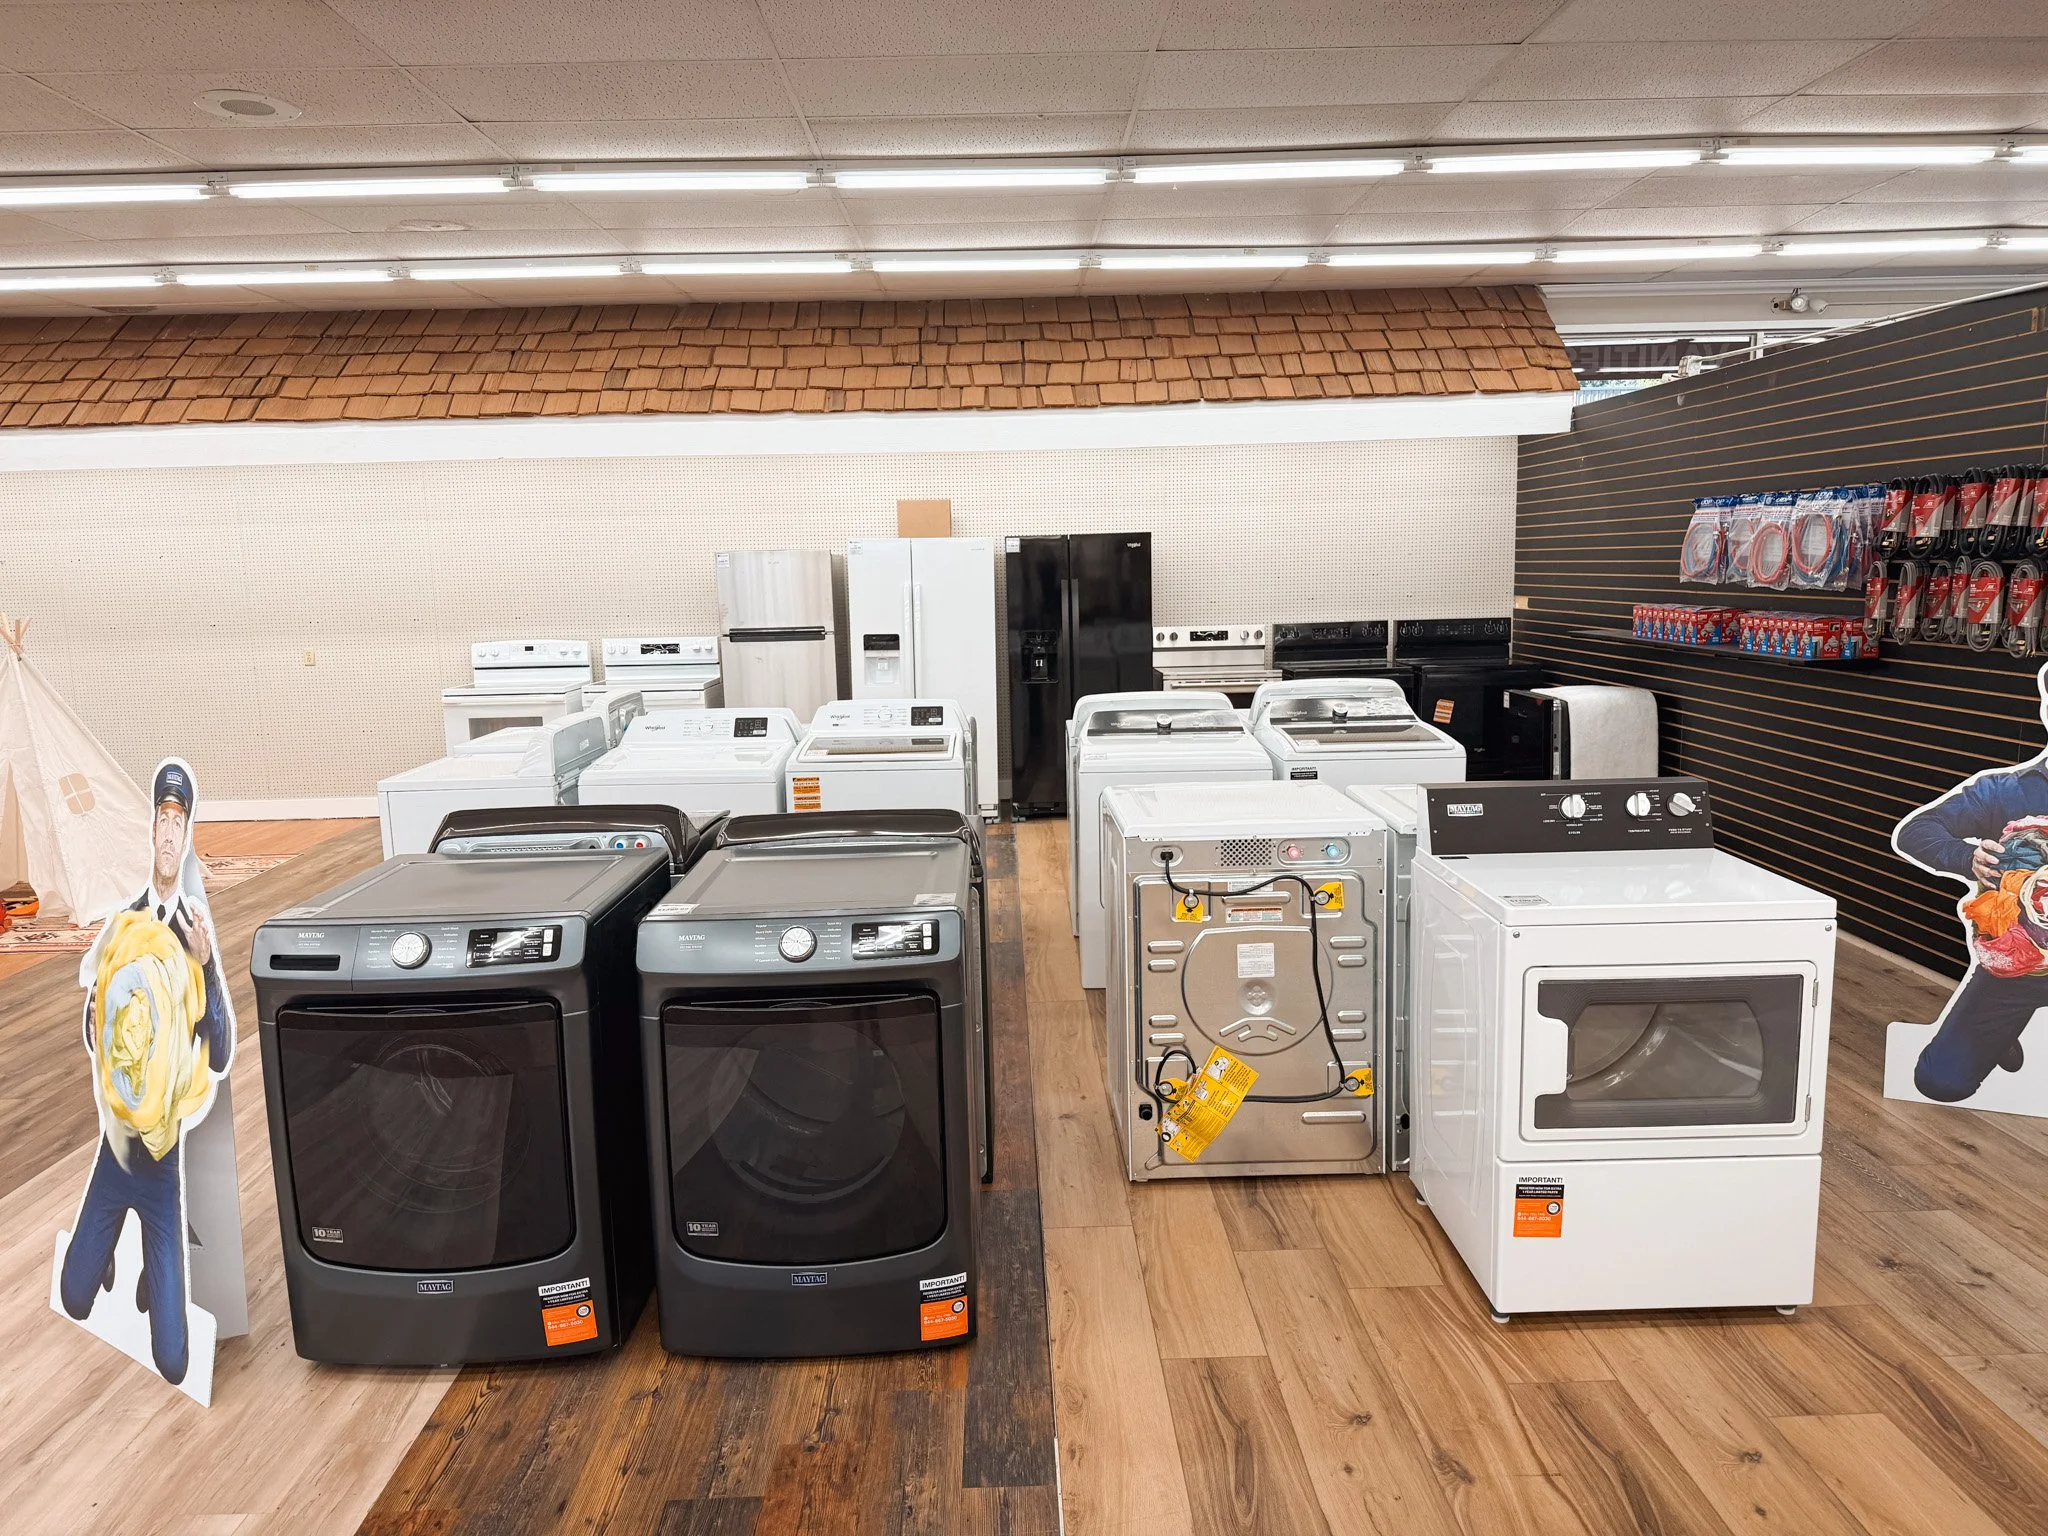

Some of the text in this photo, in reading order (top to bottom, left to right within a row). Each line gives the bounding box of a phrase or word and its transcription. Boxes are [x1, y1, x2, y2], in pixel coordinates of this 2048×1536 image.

[688, 1223, 701, 1232] 10
[313, 1228, 326, 1238] 10
[793, 1275, 826, 1284] MAYTAG
[922, 1275, 965, 1289] IMPORTANT!
[419, 1283, 452, 1292] MAYTAG
[541, 1280, 588, 1294] IMPORTANT!
